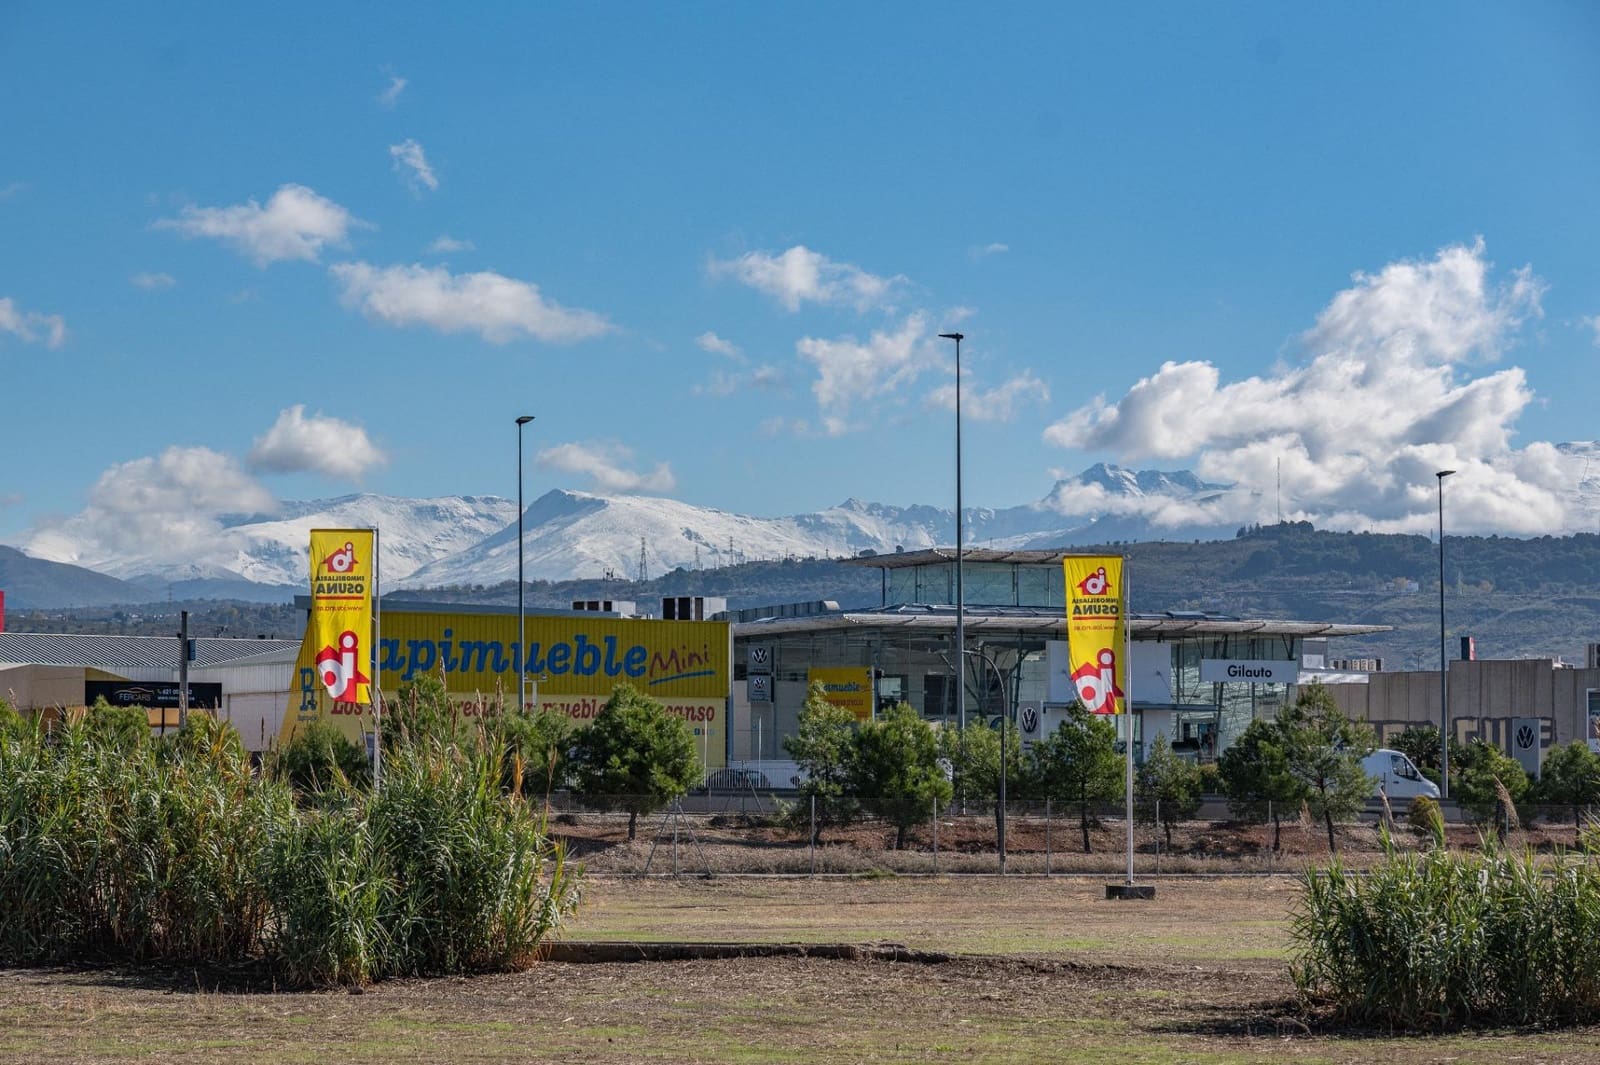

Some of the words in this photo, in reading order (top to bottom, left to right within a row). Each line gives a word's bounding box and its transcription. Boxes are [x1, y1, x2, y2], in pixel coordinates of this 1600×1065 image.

[371, 628, 647, 681] apimueble
[650, 644, 709, 678] Mini
[1227, 664, 1272, 678] Gilauto
